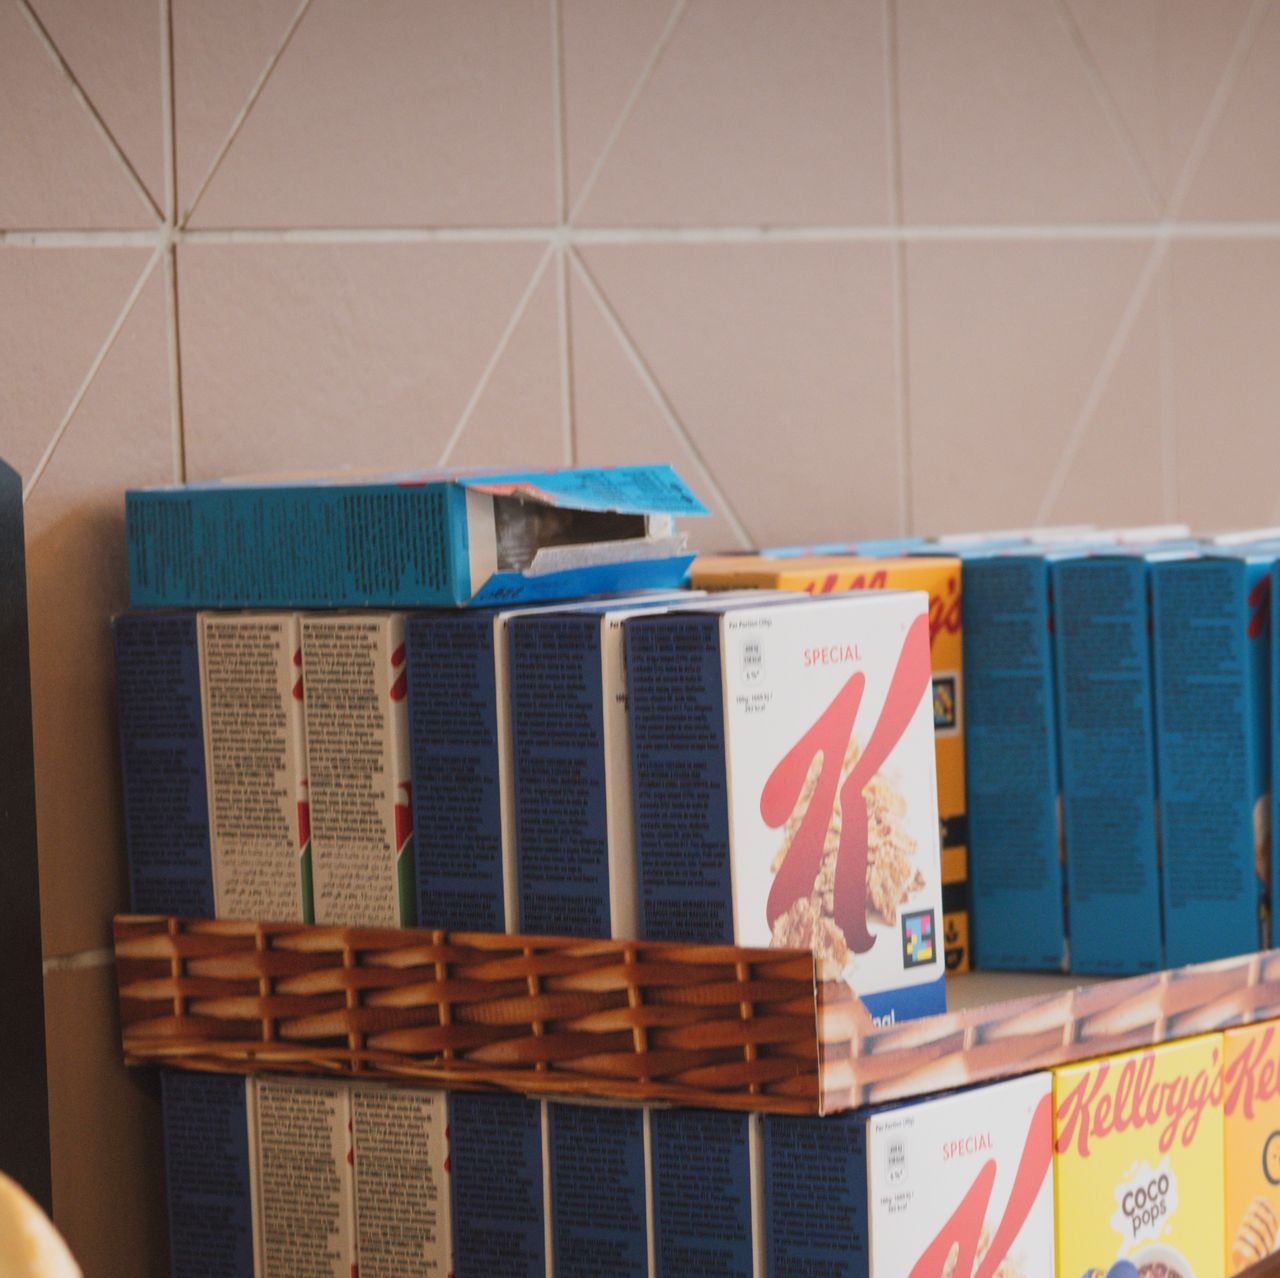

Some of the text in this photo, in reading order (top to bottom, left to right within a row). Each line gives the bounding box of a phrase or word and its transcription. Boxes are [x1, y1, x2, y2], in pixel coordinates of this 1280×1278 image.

[803, 643, 862, 668] SPECIAL
[1055, 1052, 1223, 1158] Kellogg's
[943, 1132, 993, 1161] SPECIAL
[1132, 1201, 1167, 1238] pops
